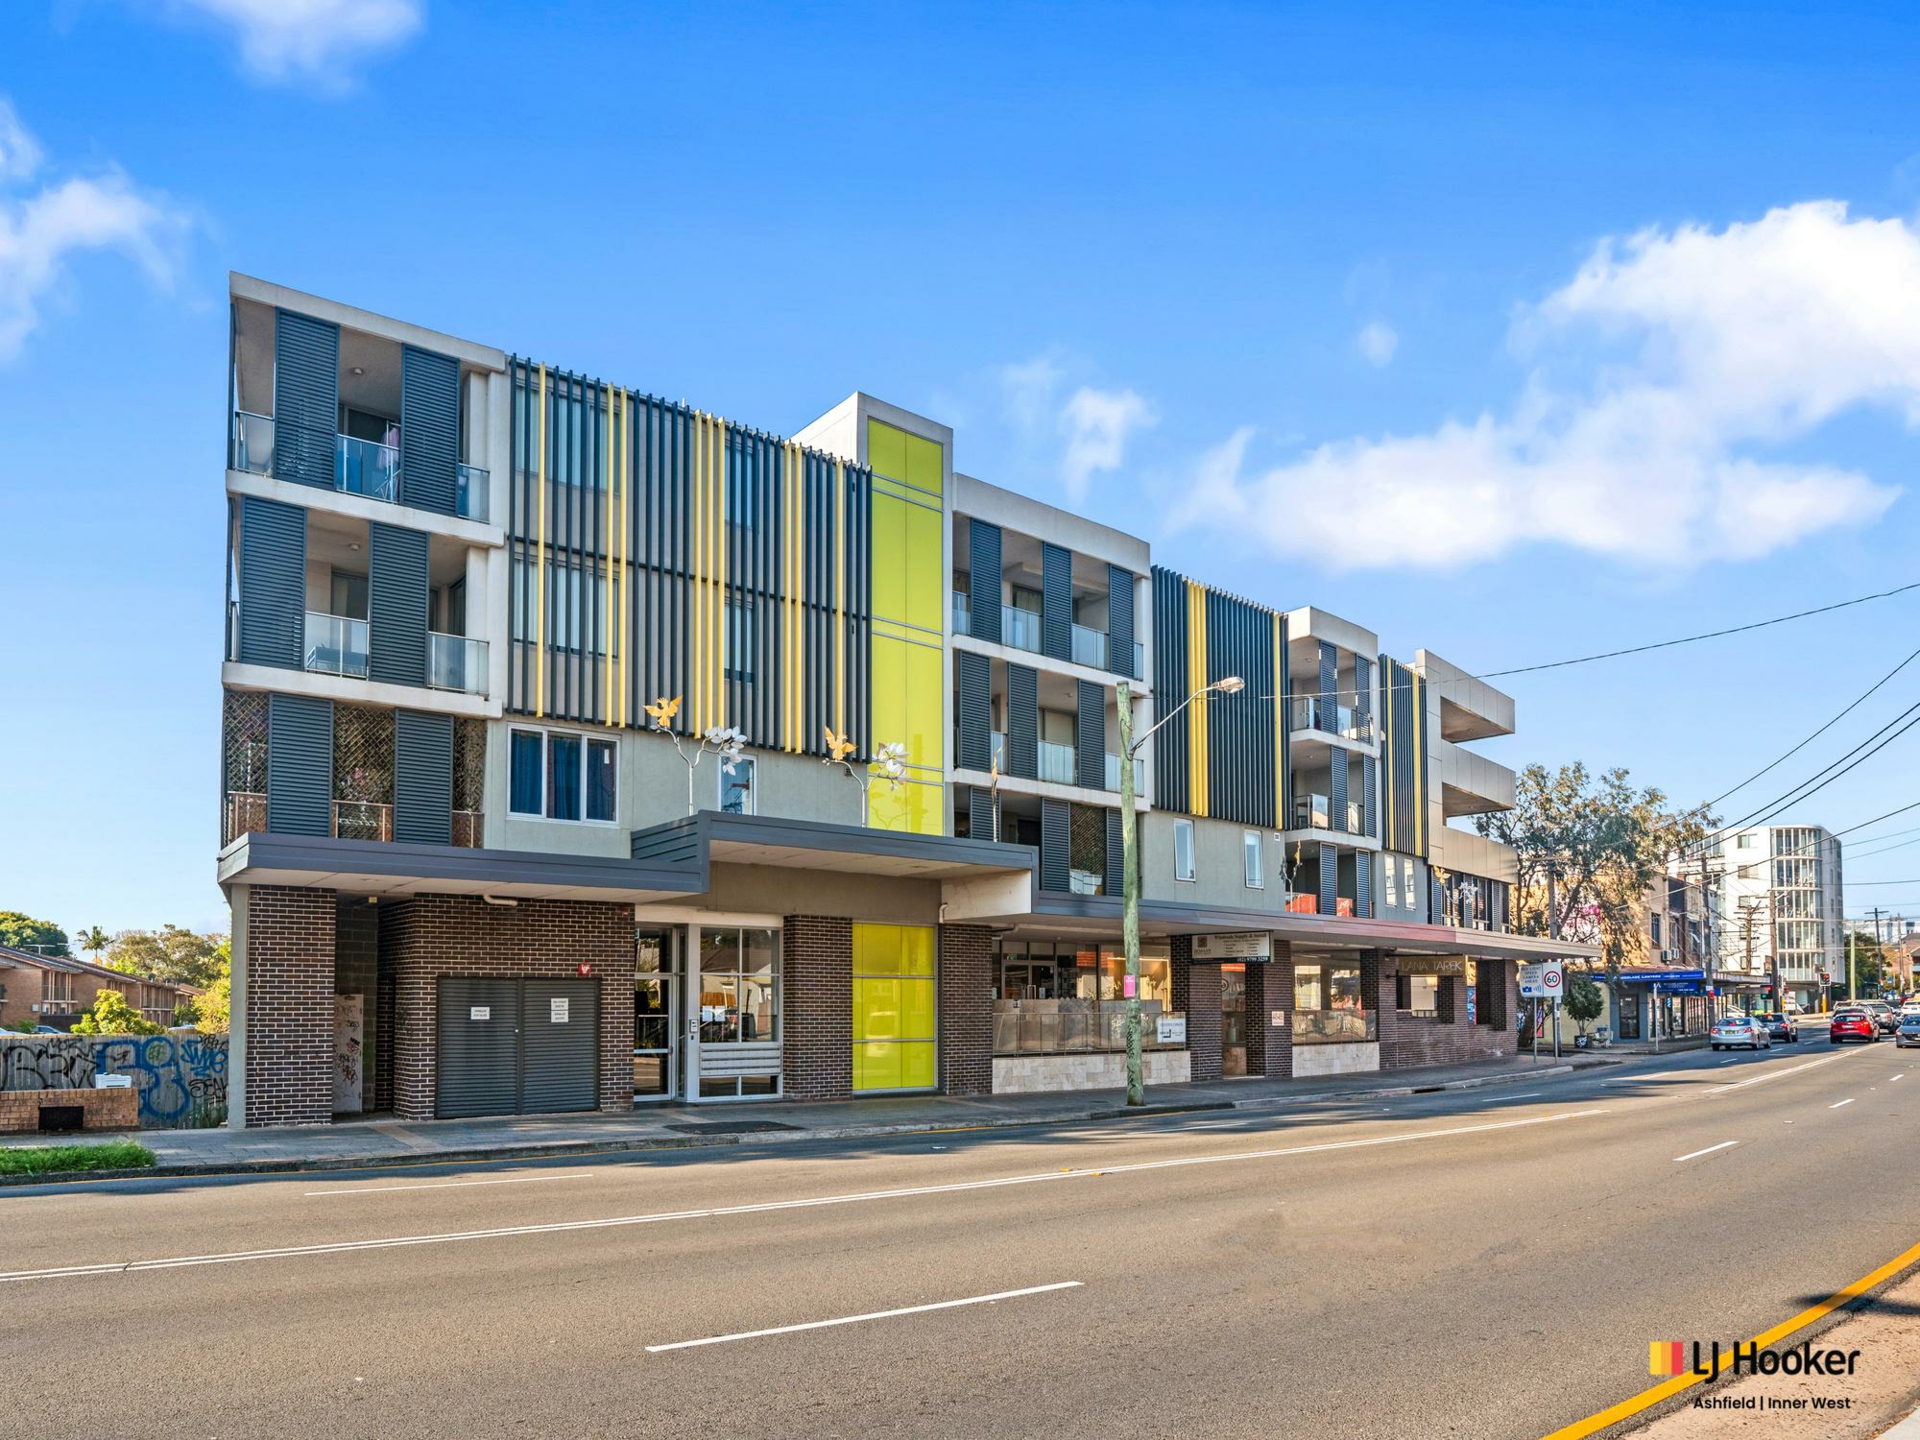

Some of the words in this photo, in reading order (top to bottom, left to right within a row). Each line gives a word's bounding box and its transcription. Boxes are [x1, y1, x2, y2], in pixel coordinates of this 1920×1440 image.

[1401, 961, 1428, 972] LANA
[1433, 960, 1462, 971] TAREK
[1547, 975, 1558, 983] 60
